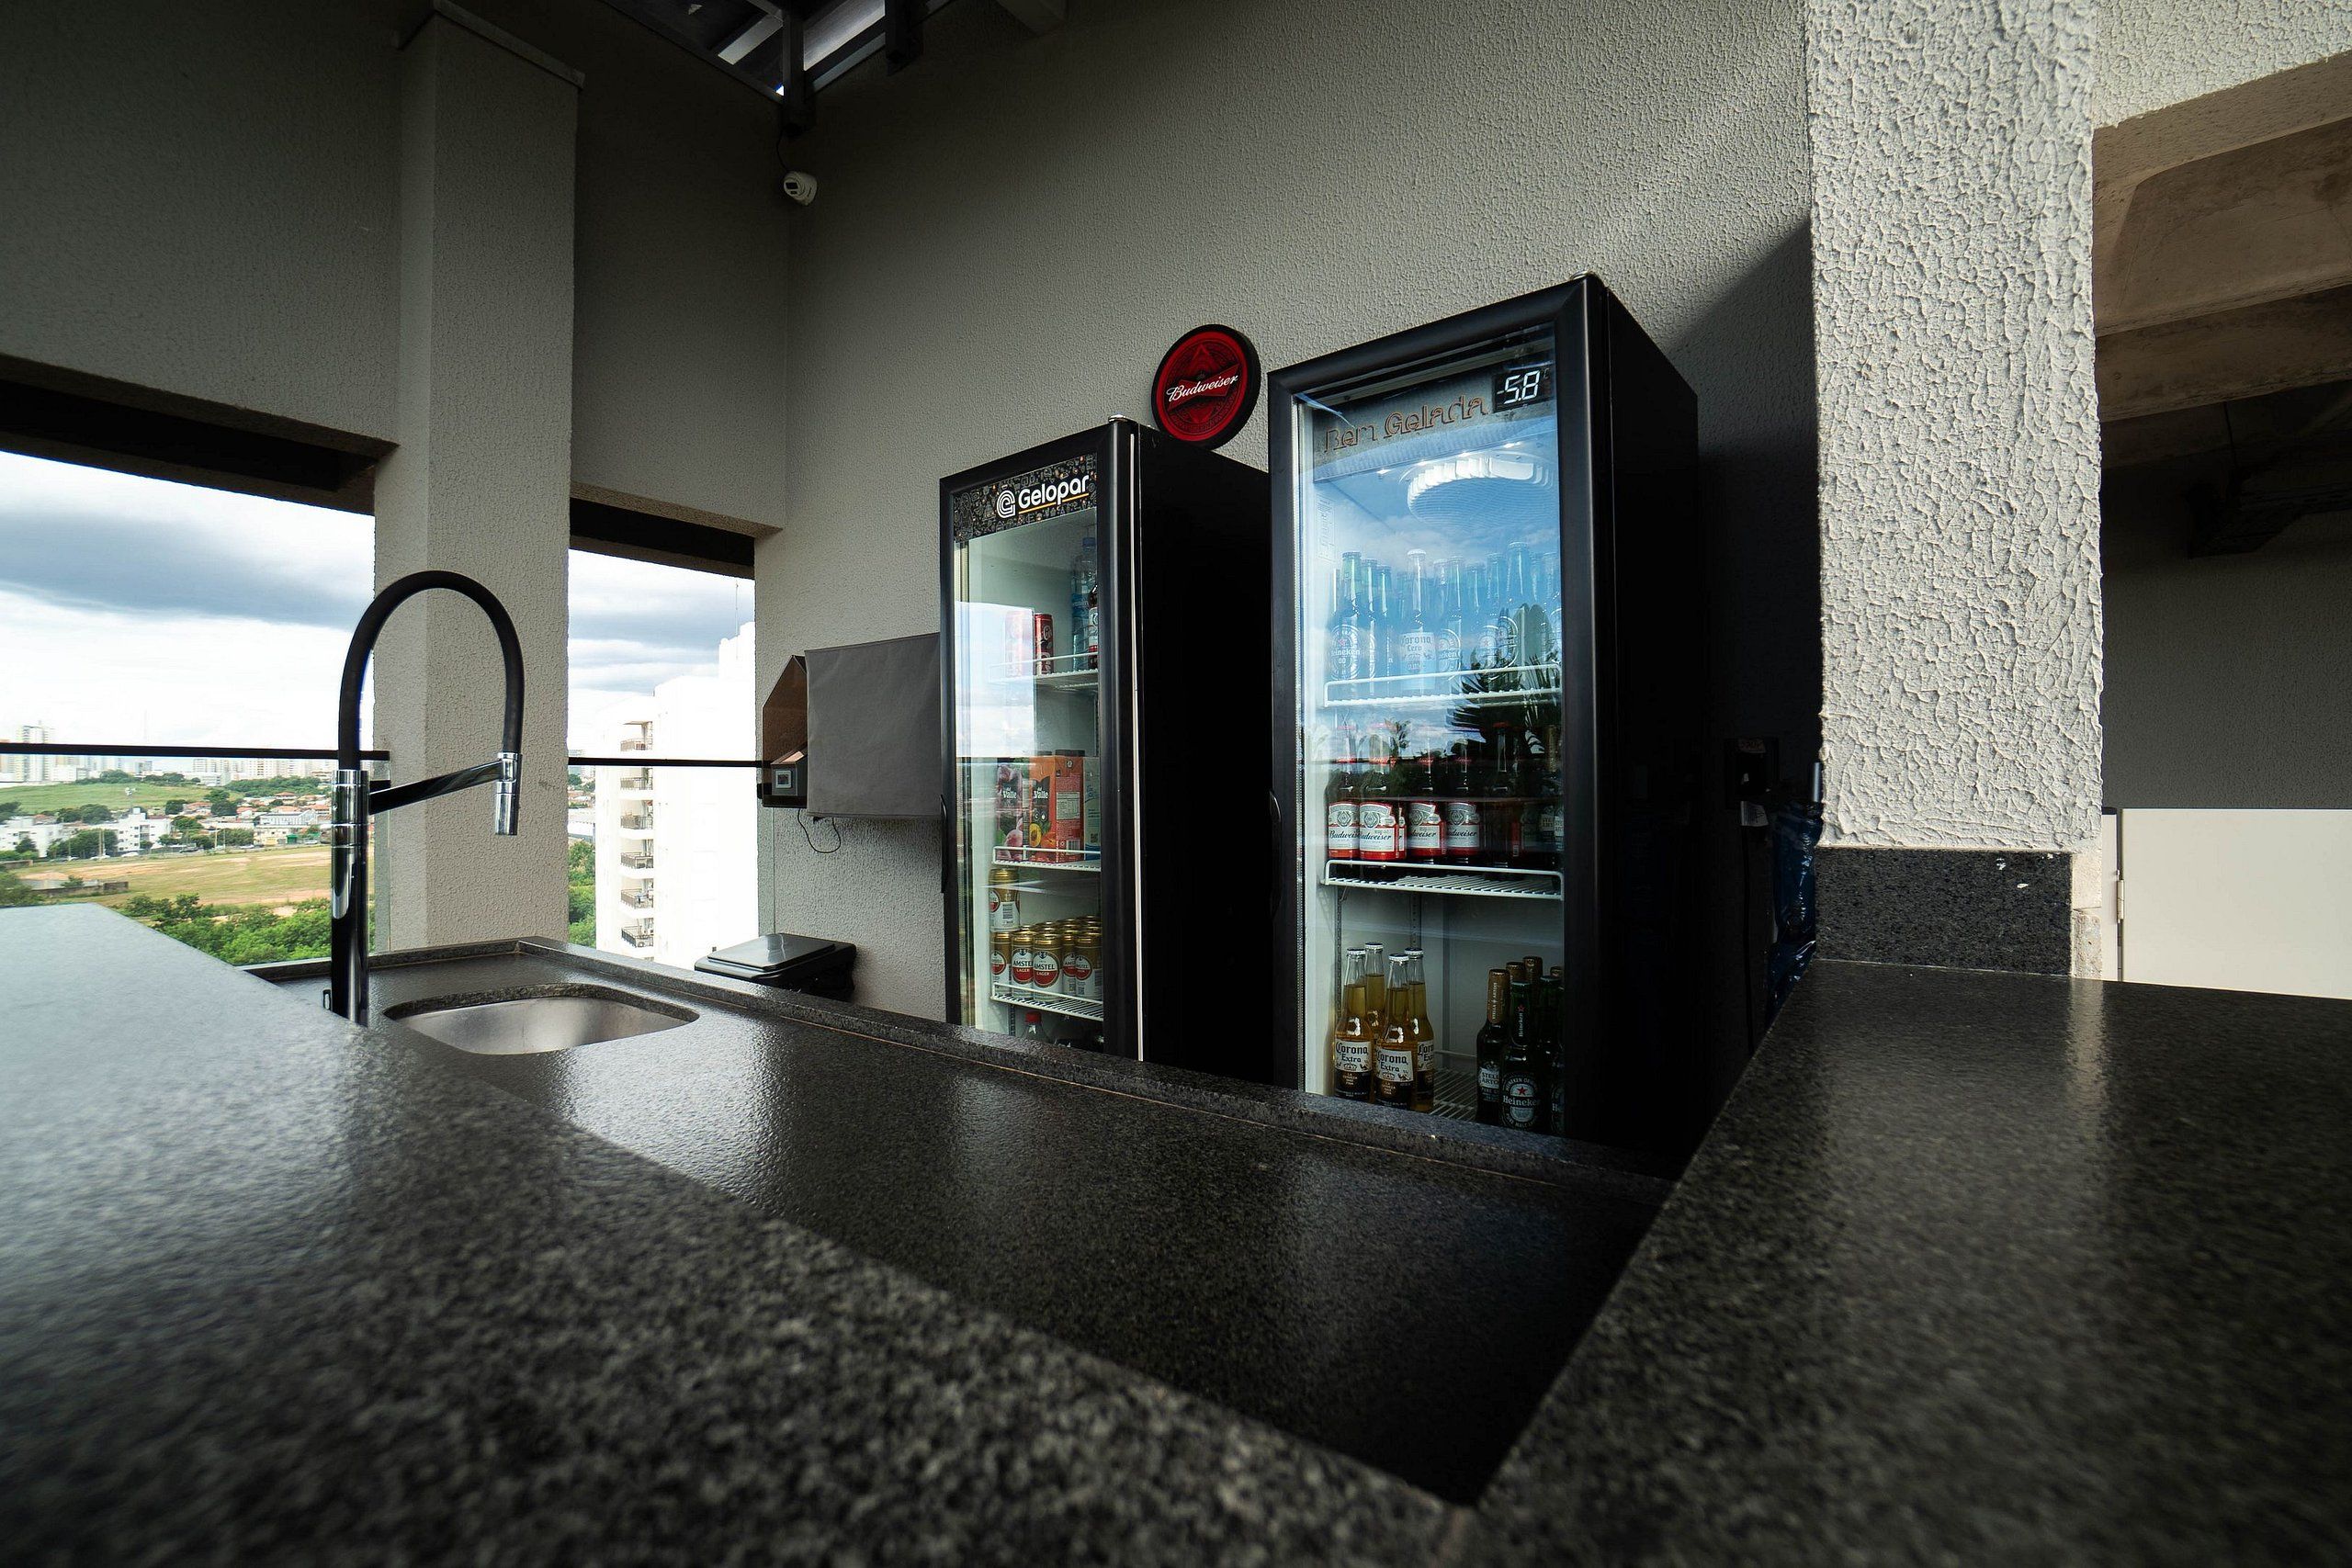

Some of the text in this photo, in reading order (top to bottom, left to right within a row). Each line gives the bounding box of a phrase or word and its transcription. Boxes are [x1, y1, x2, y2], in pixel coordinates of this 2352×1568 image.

[1166, 375, 1238, 402] Budweiser
[1383, 394, 1489, 440] Gelada
[1018, 474, 1091, 506] Gelopar
[1033, 790, 1049, 799] Valle
[1329, 829, 1360, 840] Budweis
[1336, 1043, 1369, 1055] Corona
[1341, 1054, 1362, 1063] Extra
[1377, 1051, 1409, 1065] Corona
[1380, 1063, 1400, 1073] Extra
[1502, 1095, 1538, 1107] Heineke
